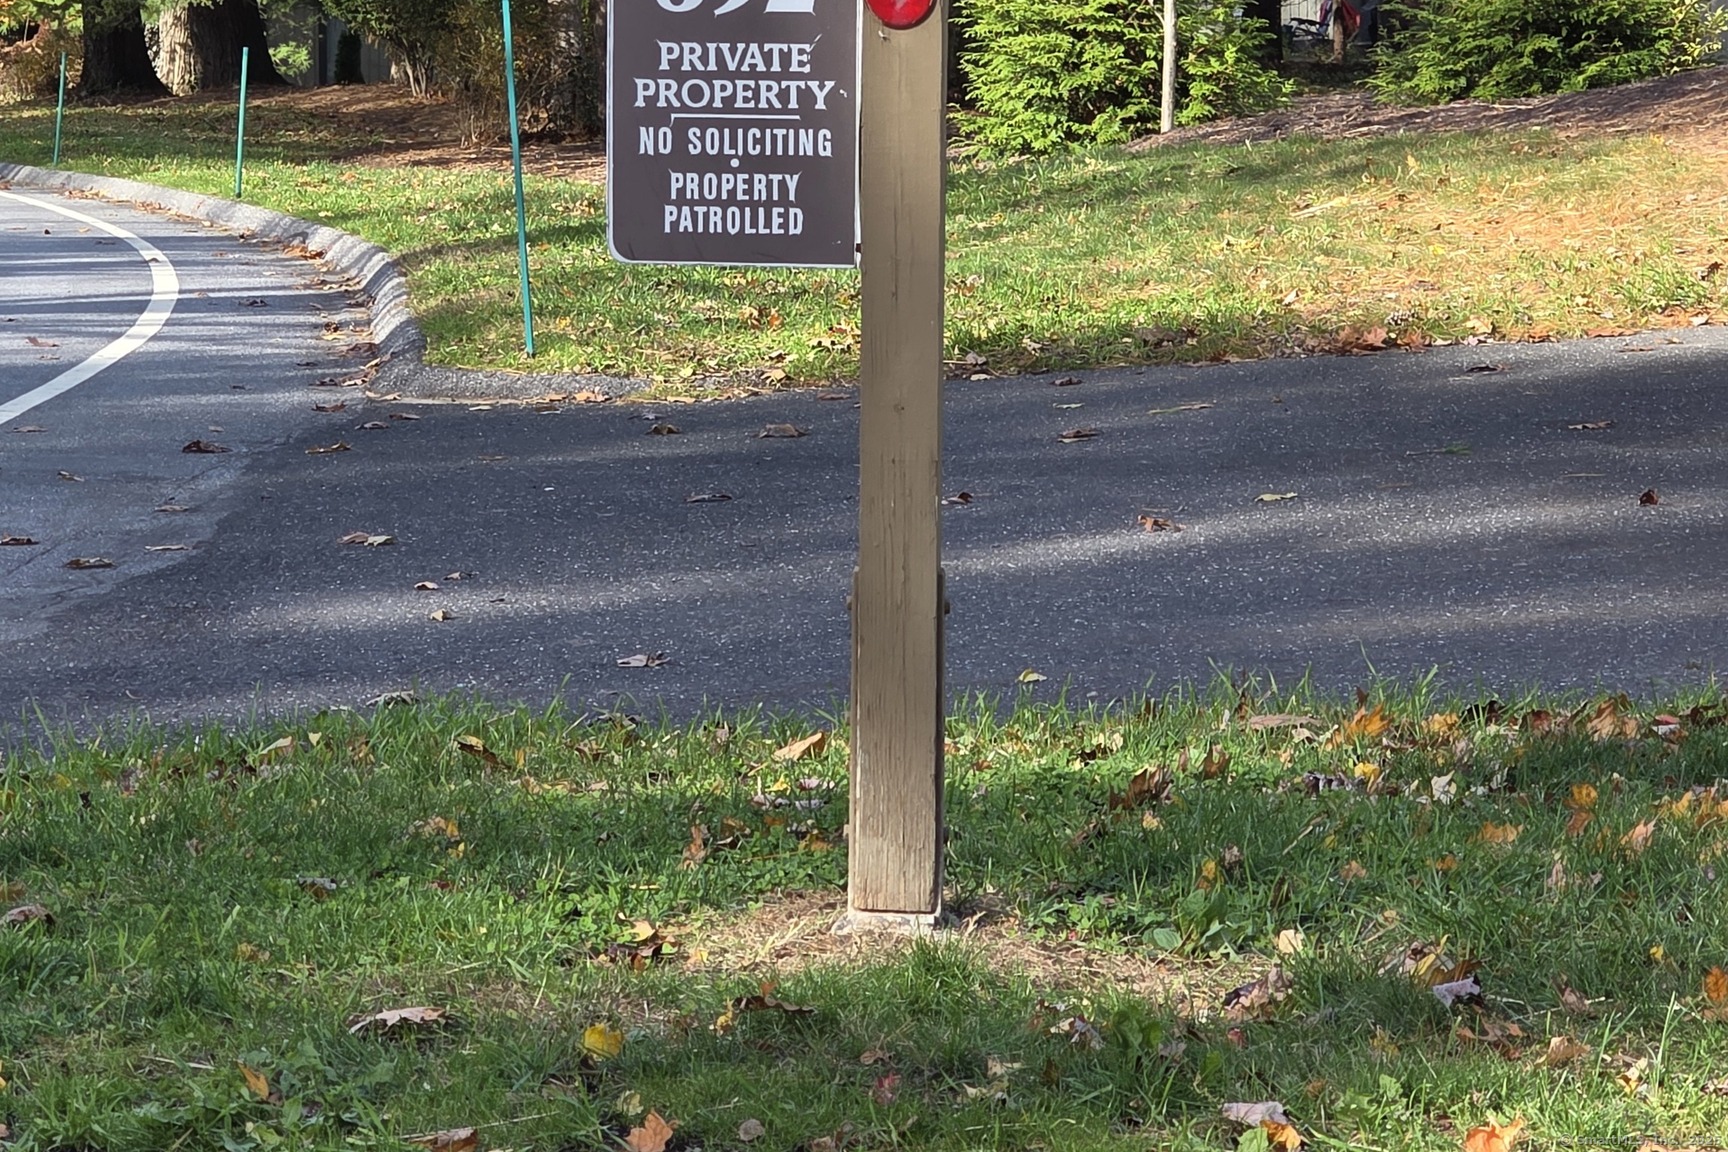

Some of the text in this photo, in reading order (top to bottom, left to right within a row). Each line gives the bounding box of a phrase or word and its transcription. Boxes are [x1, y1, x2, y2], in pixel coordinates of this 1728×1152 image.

[657, 41, 813, 73] PRIVATE
[633, 78, 835, 110] PROPERTY
[638, 126, 833, 158] NO SOLICITING
[669, 170, 802, 202] PROPERTY
[663, 205, 804, 236] PATROLLED
